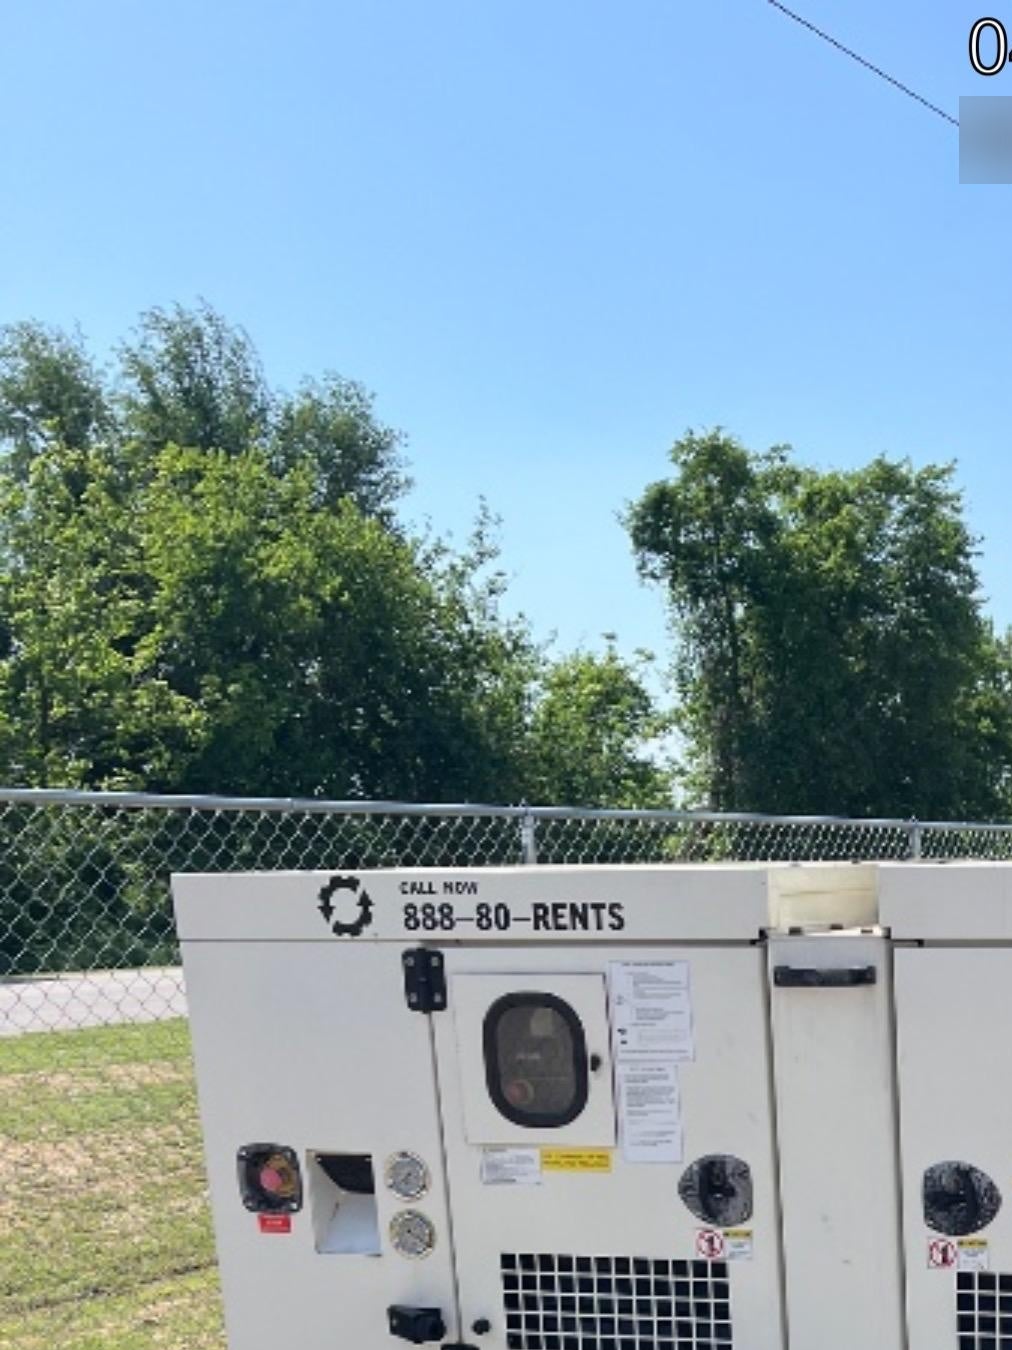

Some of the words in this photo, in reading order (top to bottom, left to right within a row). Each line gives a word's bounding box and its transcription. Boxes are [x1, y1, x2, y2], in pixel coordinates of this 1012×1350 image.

[399, 881, 438, 895] CALL
[443, 881, 478, 895] NOW
[404, 903, 625, 930] 888-80-RENTS
